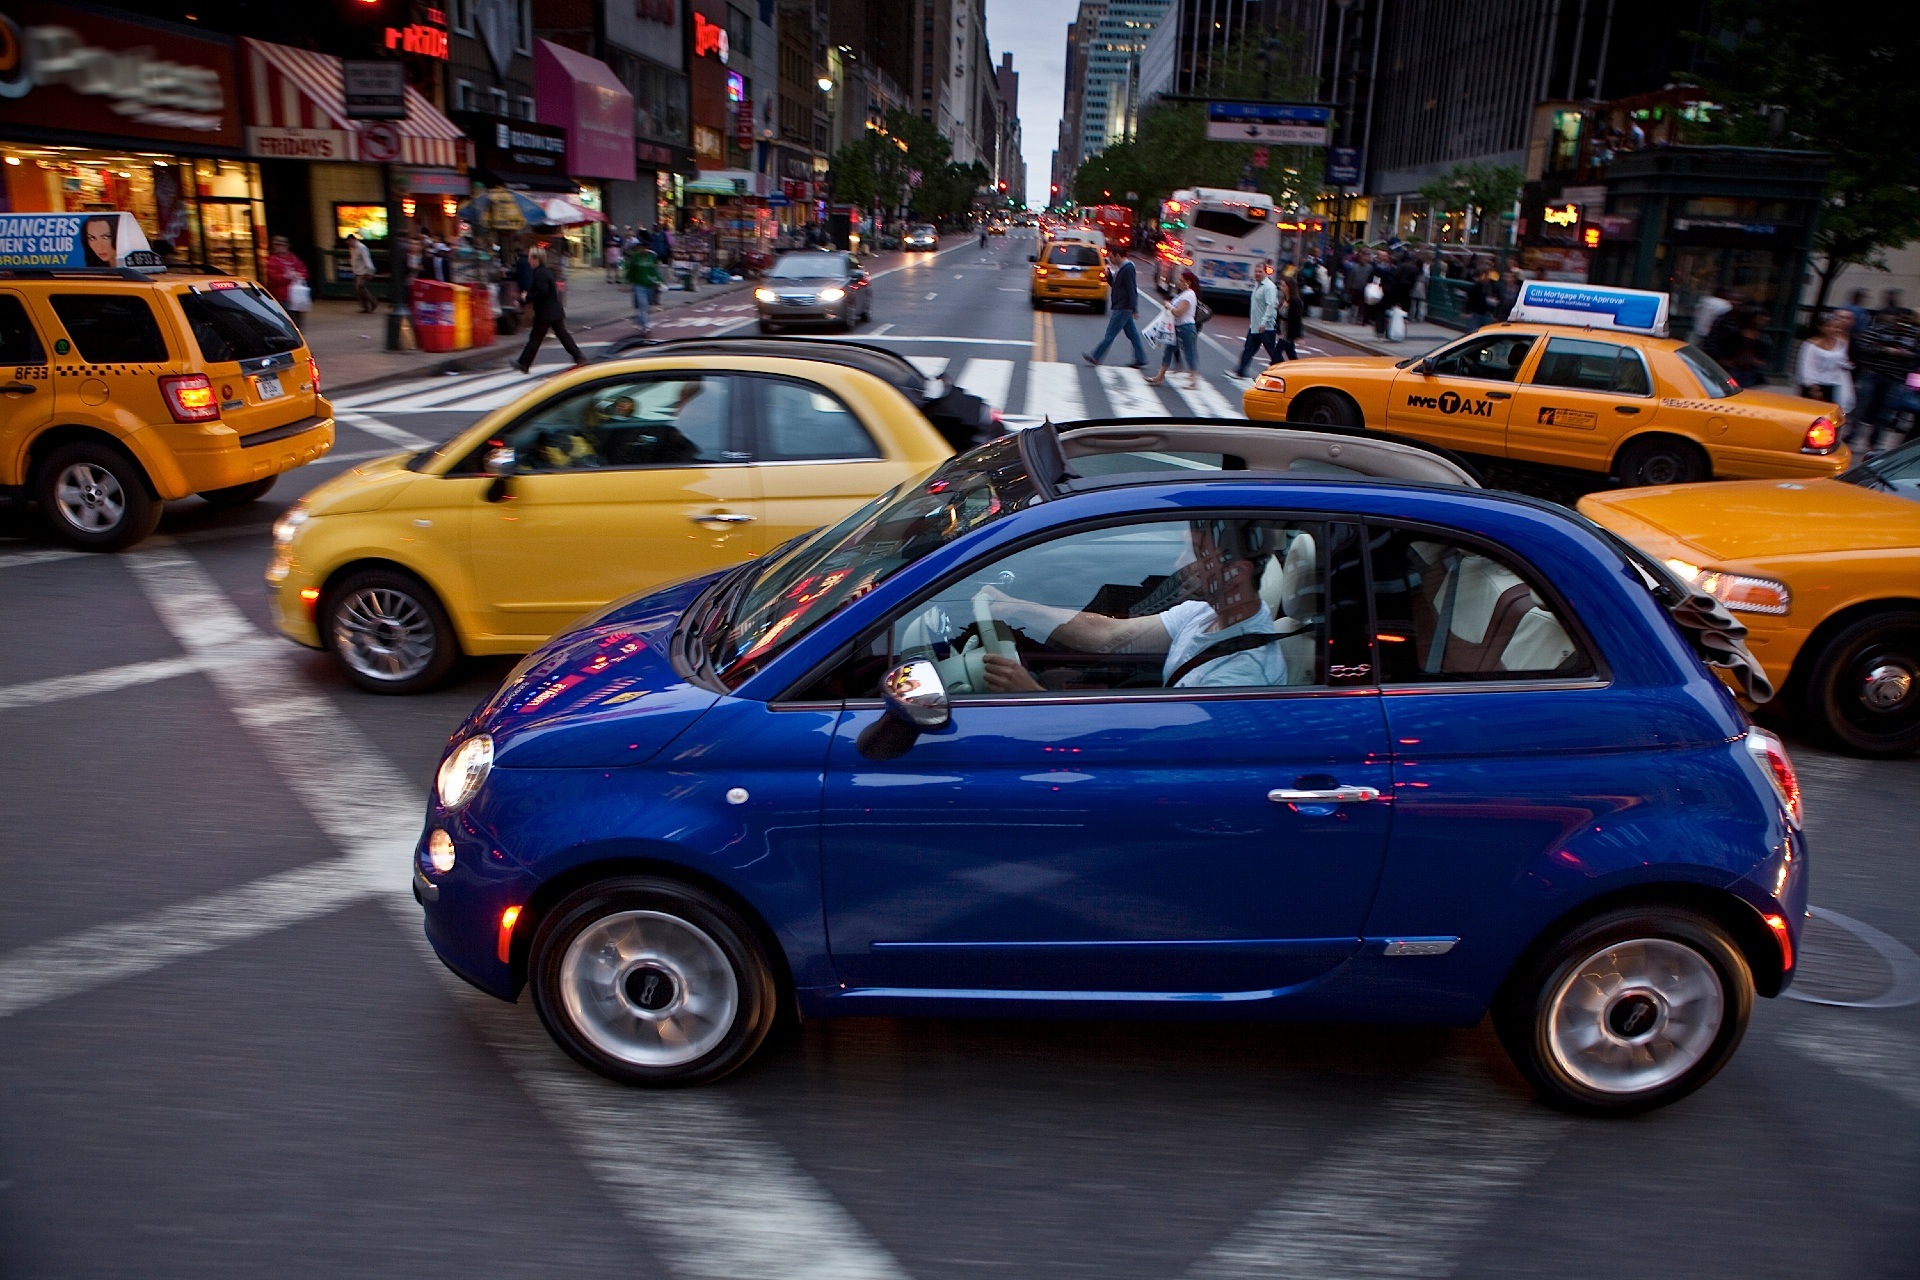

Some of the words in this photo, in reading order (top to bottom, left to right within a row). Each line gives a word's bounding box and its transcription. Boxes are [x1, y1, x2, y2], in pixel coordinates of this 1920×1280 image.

[40, 237, 74, 253] CLUB
[1530, 289, 1543, 297] Citi
[1544, 291, 1577, 300] Mortgage
[1578, 293, 1626, 304] Pre-Approval
[15, 367, 48, 380] 8F33
[1407, 395, 1437, 409] NYC
[1438, 391, 1494, 417] TAXI
